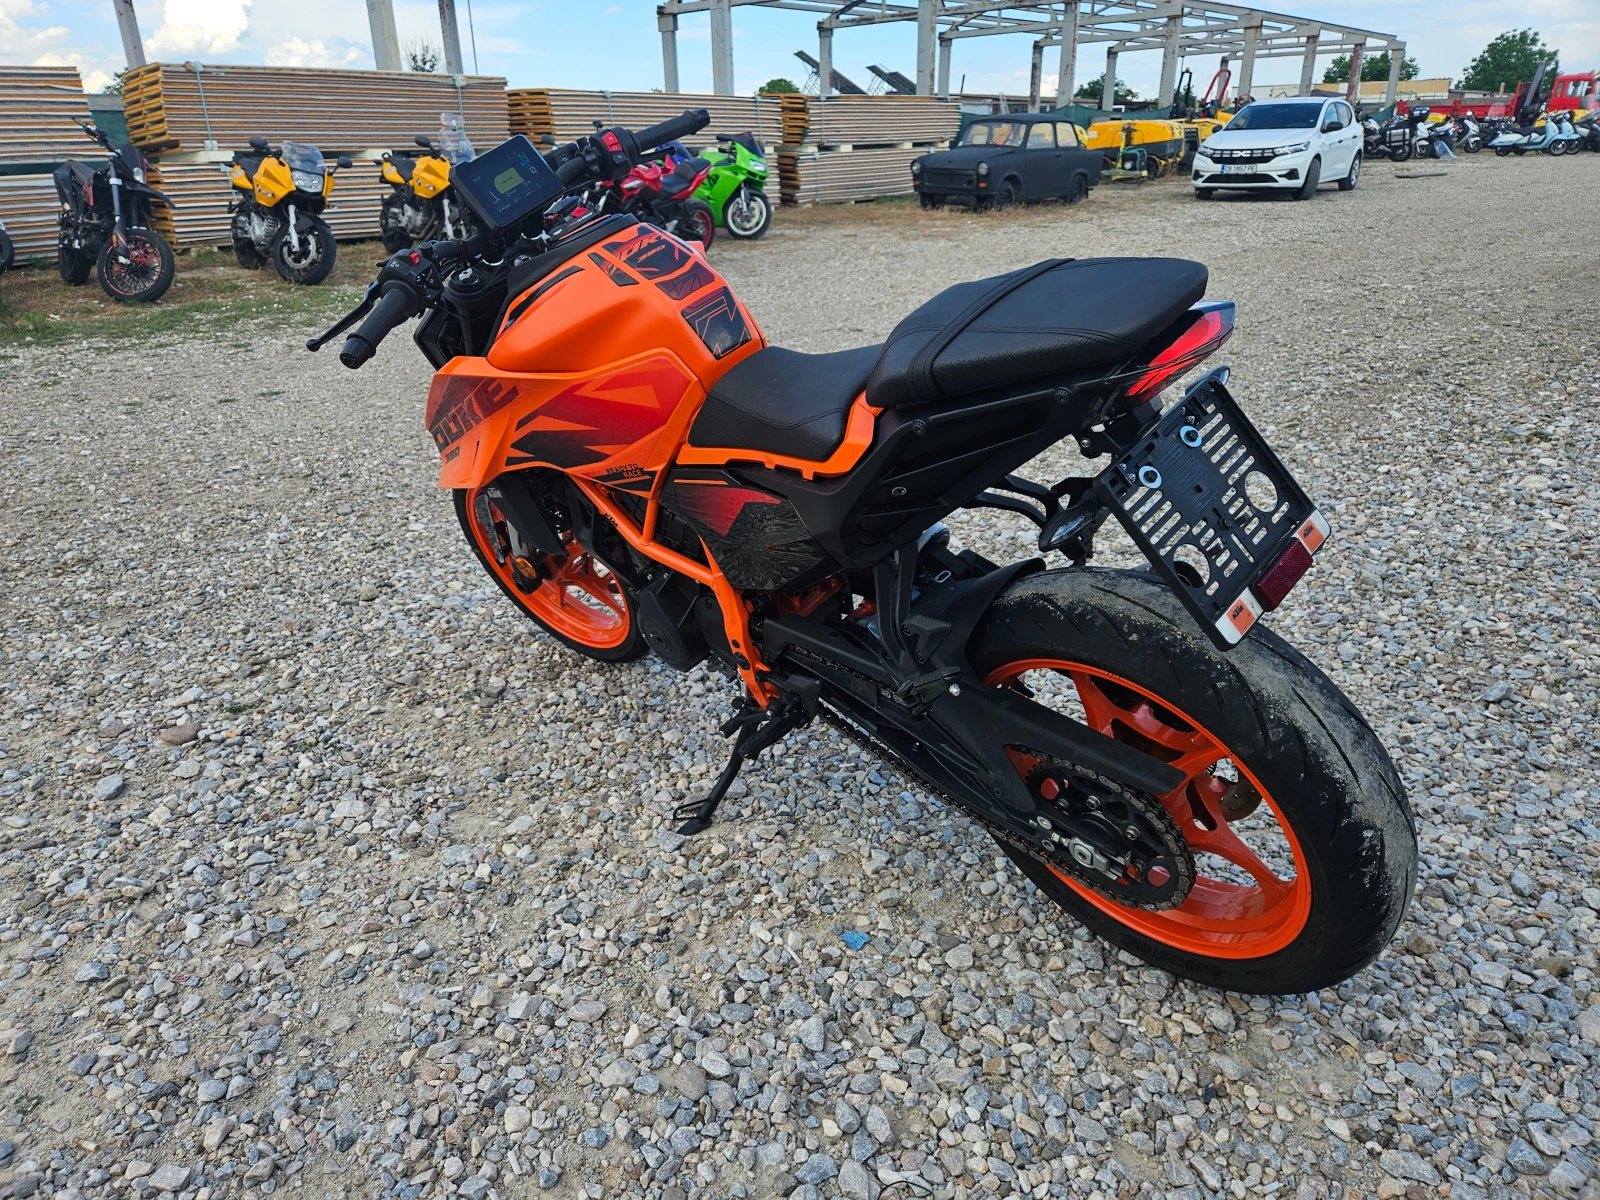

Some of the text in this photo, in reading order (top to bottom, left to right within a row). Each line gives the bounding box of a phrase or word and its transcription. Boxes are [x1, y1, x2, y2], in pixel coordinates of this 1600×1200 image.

[430, 378, 520, 453] DUKE
[444, 445, 460, 464] 390
[606, 463, 639, 475] READY TO
[623, 469, 643, 478] RACE
[487, 487, 502, 499] KTM
[1303, 525, 1314, 539] KTM
[1232, 605, 1244, 621] KTM
